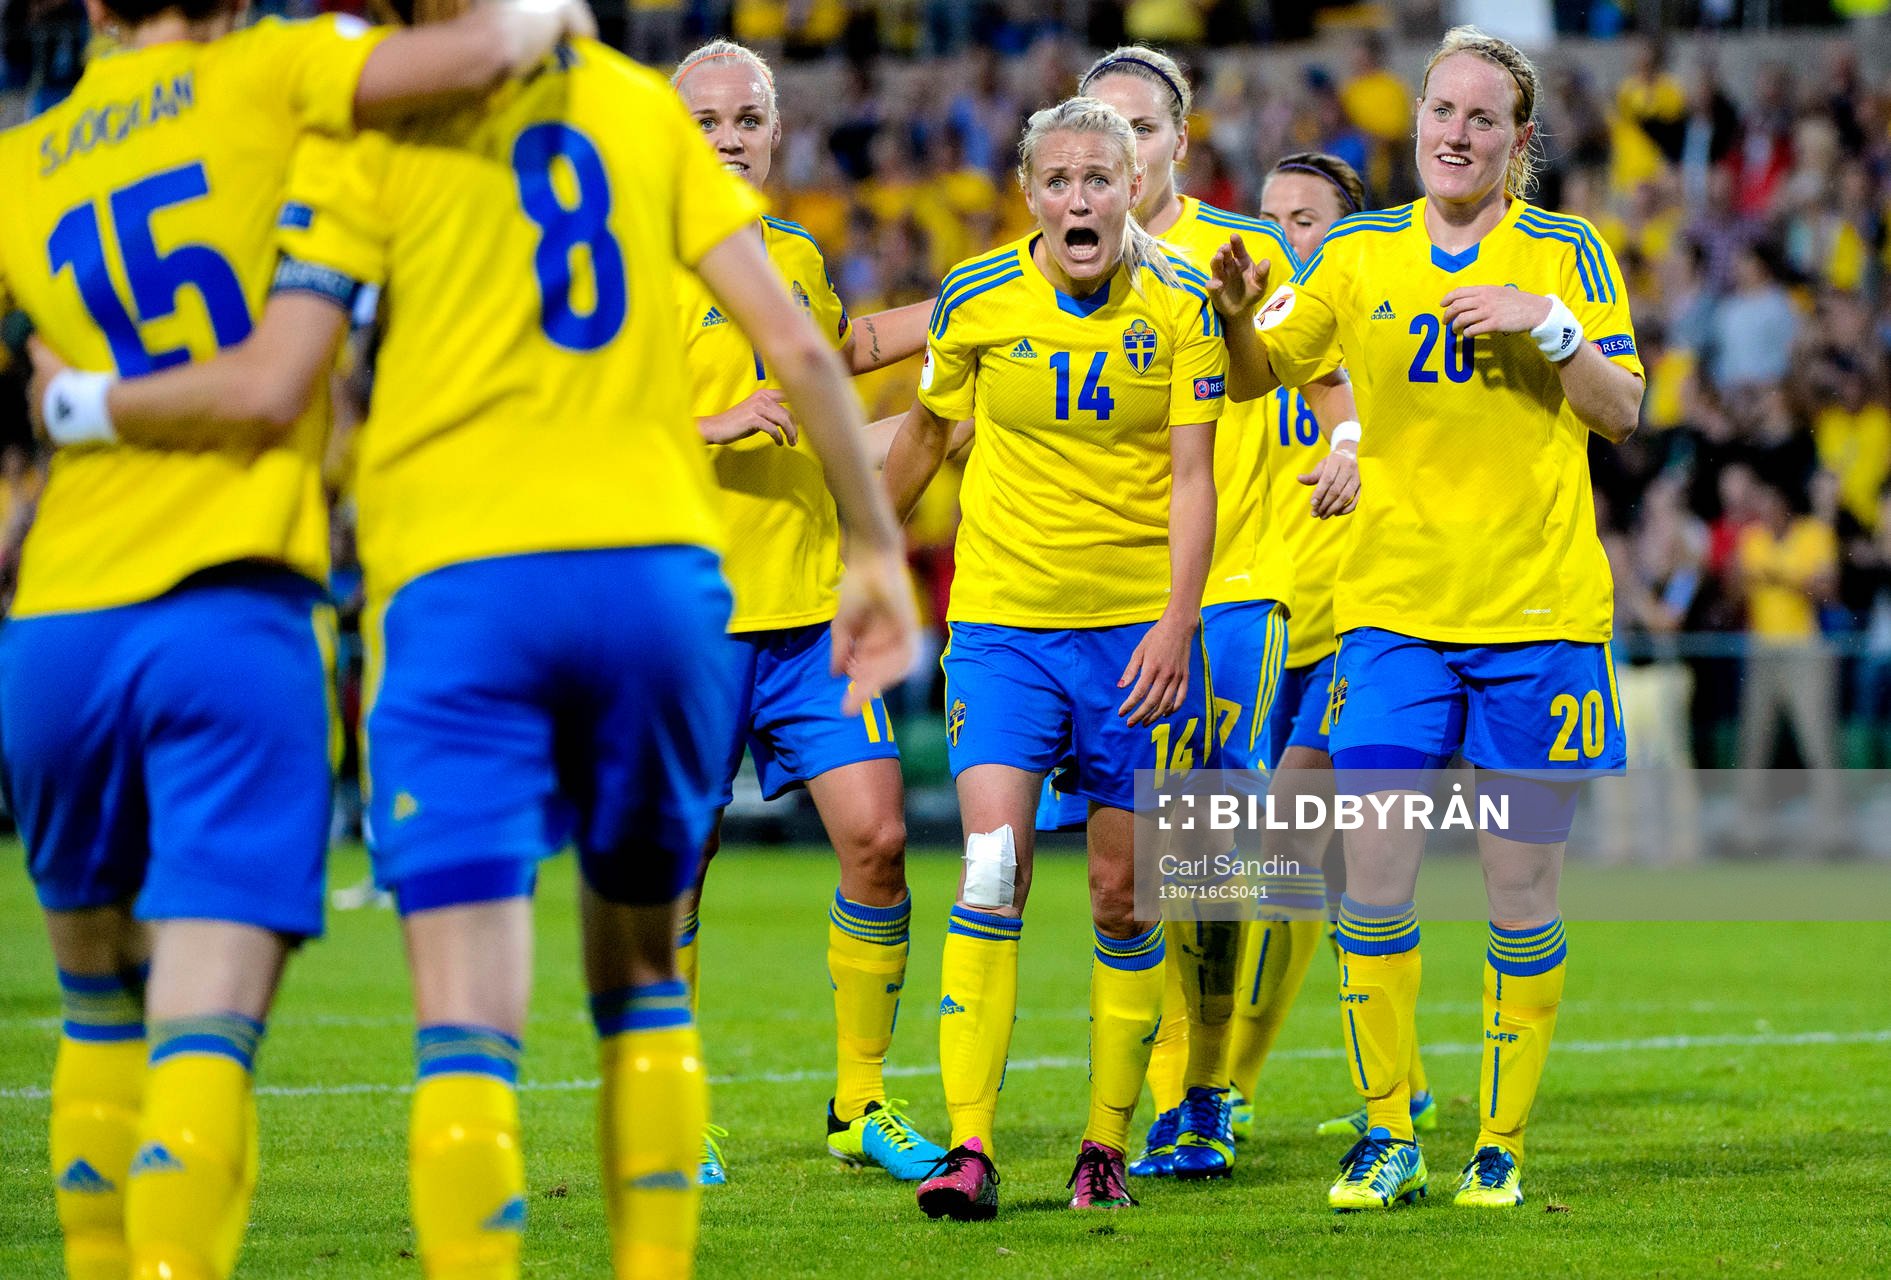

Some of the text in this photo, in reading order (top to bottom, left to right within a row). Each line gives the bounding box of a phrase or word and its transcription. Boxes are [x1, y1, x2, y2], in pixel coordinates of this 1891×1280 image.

[48, 162, 253, 378] 15
[511, 121, 629, 351] 8
[1370, 311, 1396, 320] adidas
[1408, 313, 1475, 384] 20
[1010, 350, 1038, 359] adidas
[1050, 351, 1115, 420] 14
[1276, 385, 1320, 447] 18
[1151, 717, 1199, 790] 14
[1549, 689, 1605, 762] 20
